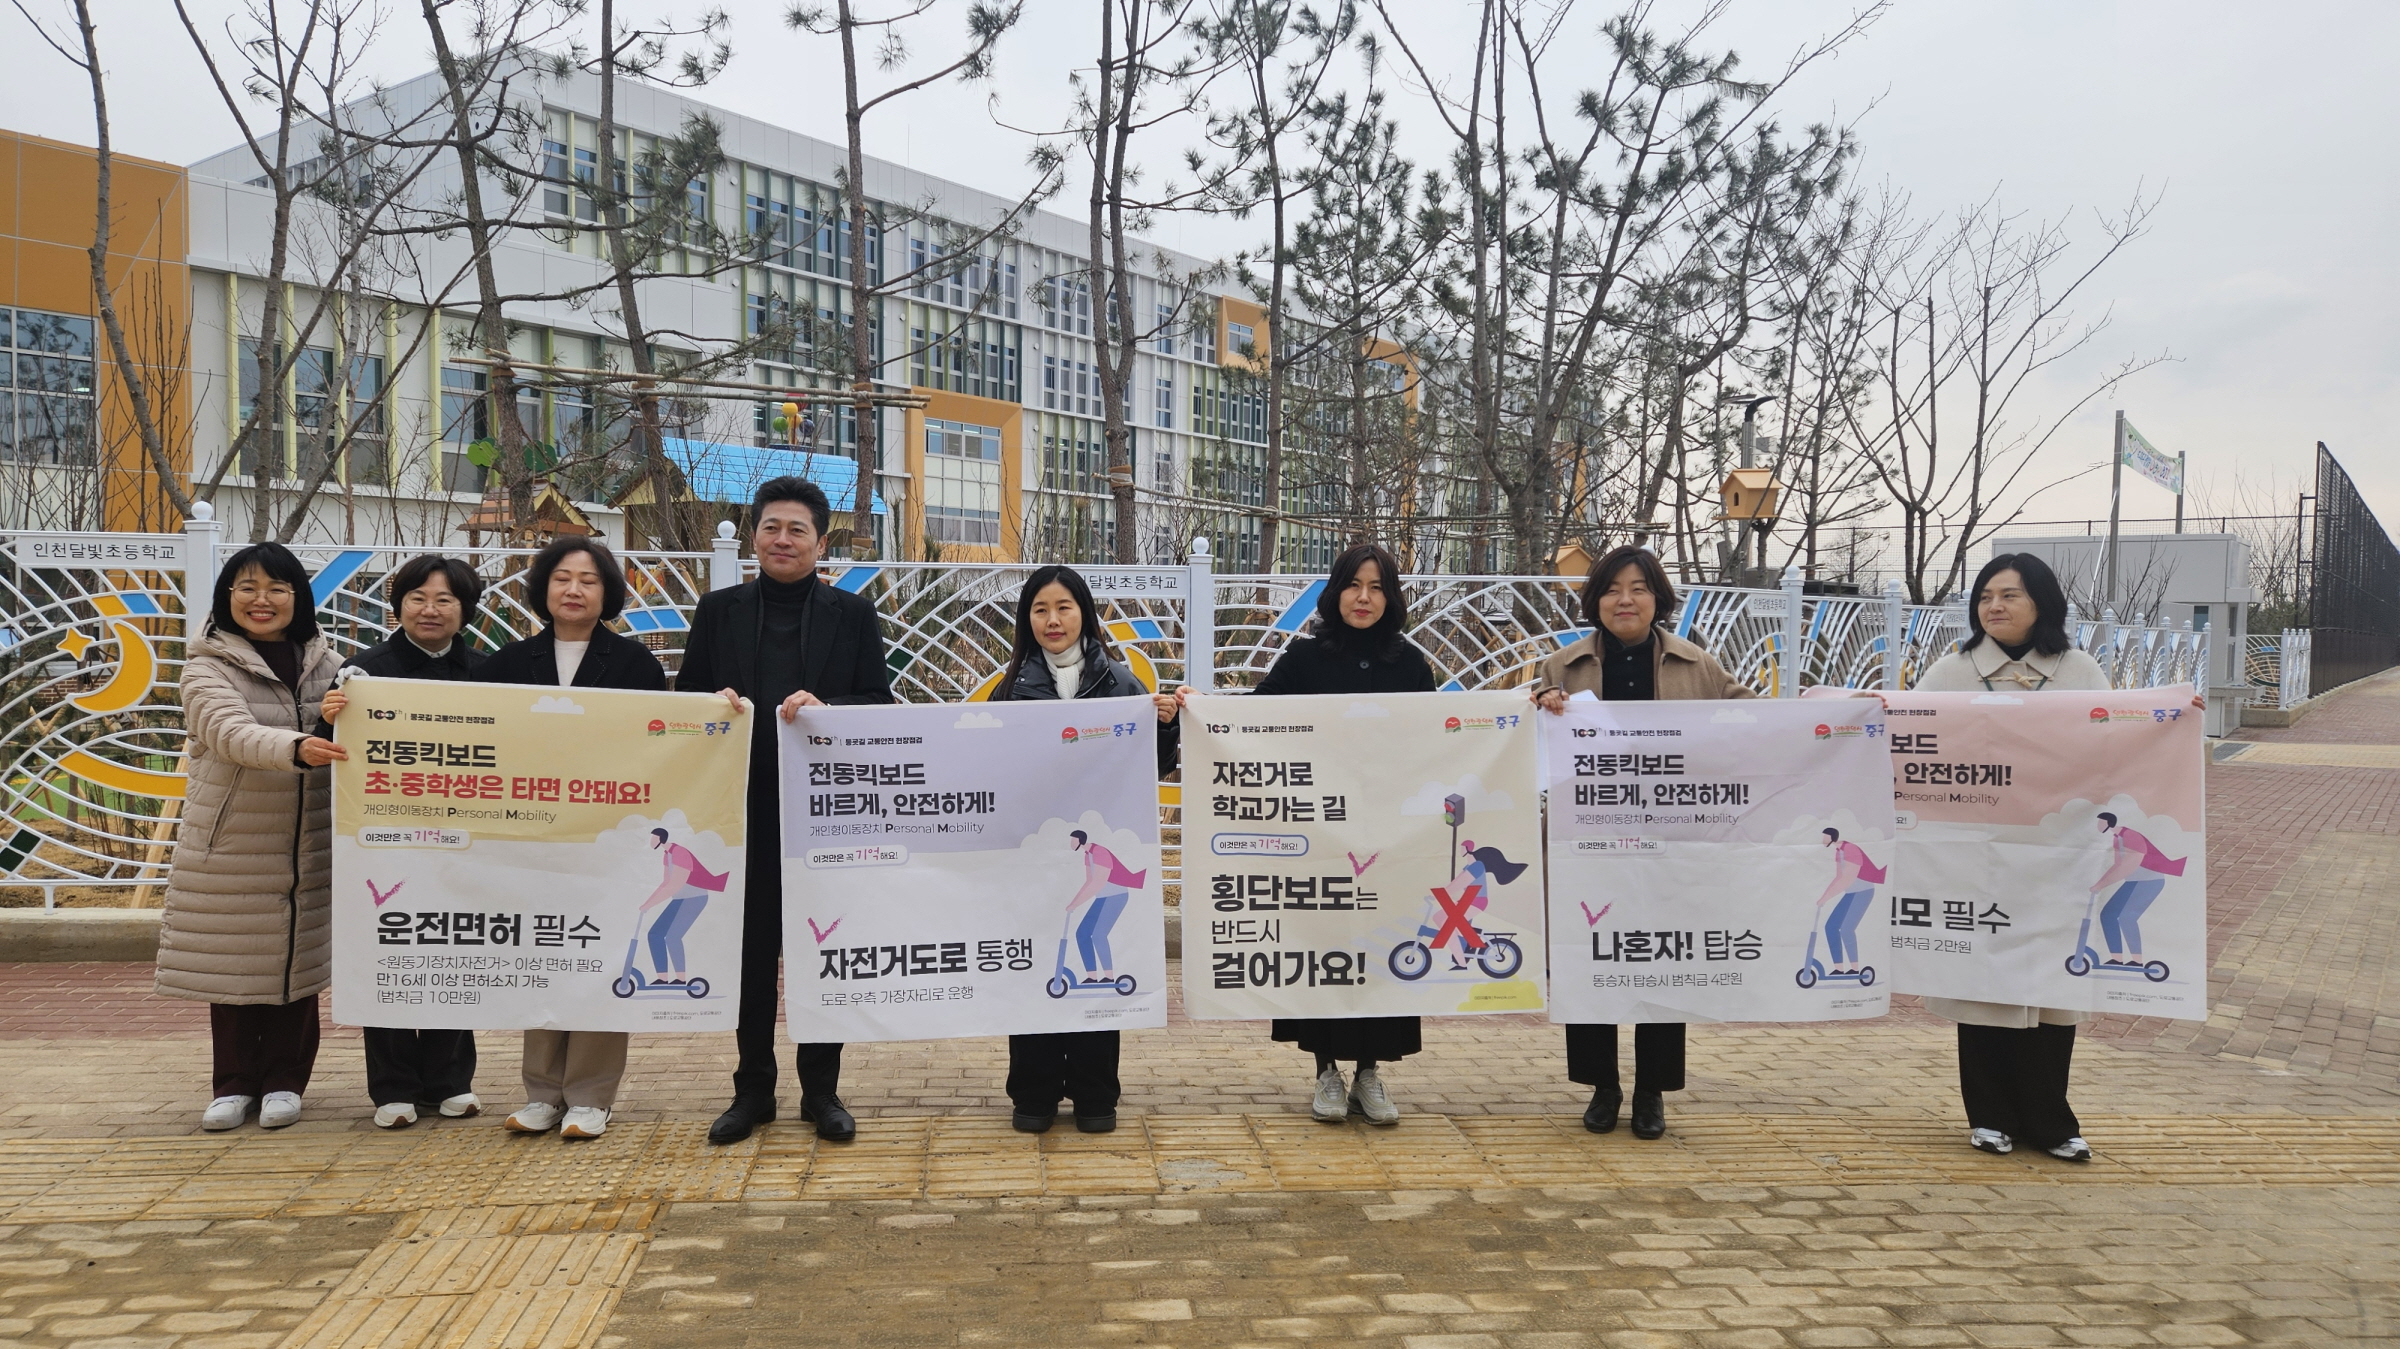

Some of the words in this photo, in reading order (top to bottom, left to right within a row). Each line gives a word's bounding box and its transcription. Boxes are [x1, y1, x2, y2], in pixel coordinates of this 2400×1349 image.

[34, 543, 175, 560] 인천달빛초등학교
[1083, 575, 1178, 590] 달빛초등학교
[1496, 716, 1519, 729] 중구
[2153, 709, 2181, 722] 중구
[705, 722, 730, 735] 중구
[1114, 723, 1136, 737] 중구
[1865, 724, 1884, 737] 중구
[1891, 734, 1938, 754] 보드
[366, 740, 496, 767] 전동킥보드
[1574, 754, 1684, 776] 전동킥보드
[809, 763, 925, 786] 전동킥보드
[1213, 762, 1313, 787] 자전거로
[1904, 763, 2011, 786] 안전하게!
[365, 771, 503, 799] 초·중학생은
[512, 777, 560, 802] 타면
[568, 780, 650, 804] 안돼요!
[1576, 784, 1647, 809] 바르게,
[1654, 784, 1748, 805] 안전하게!
[810, 794, 887, 818] 바르게,
[894, 792, 995, 815] 안전하게!
[1895, 792, 1945, 801] Personal
[1950, 794, 1999, 806] Mobility
[364, 805, 443, 817] 개인형이동장치
[448, 808, 503, 818] Personal
[506, 807, 557, 823] Mobility
[1213, 795, 1314, 822] 학교가는
[1323, 796, 1346, 821] 길
[1576, 814, 1642, 824] 개인형이동장치
[1645, 814, 1692, 824] Personal
[1695, 814, 1739, 826] Mobility
[366, 832, 400, 841] 이것만은
[810, 824, 882, 836] 개인형이동장치
[886, 824, 934, 833] Personal
[938, 823, 984, 833] Mobility
[1219, 840, 1248, 849] 이것만은
[1578, 842, 1607, 850] 이것만은
[814, 854, 844, 863] 이것만은
[1212, 874, 1378, 912] 횡단보도는
[1943, 901, 2010, 934] 필수
[378, 912, 521, 946] 운전면허
[534, 915, 600, 948] 필수
[1212, 919, 1279, 944] 반드시
[1593, 930, 1693, 962] 나혼자!
[1705, 930, 1762, 960] 탑승
[1891, 936, 1929, 950] 범칙금
[1935, 940, 1971, 954] 2만원
[378, 956, 510, 970] <원동기장치자전거>
[515, 958, 543, 970] 이상
[547, 958, 572, 971] 면허
[577, 959, 602, 972] 필요
[820, 943, 967, 980] 자전거도로
[977, 939, 1032, 972] 통행
[1213, 951, 1365, 989] 걸어가요!
[377, 973, 426, 986] 만16세
[432, 974, 459, 986] 이상
[463, 974, 517, 987] 면허소지
[523, 975, 549, 988] 가능
[1593, 975, 1630, 987] 동승자
[1634, 975, 1668, 987] 탑승시
[1673, 974, 1707, 986] 범칙금
[1711, 973, 1742, 985] 4만원
[378, 990, 423, 1004] (범칙금
[430, 991, 480, 1004] 10만원)
[822, 994, 847, 1006] 도로
[851, 992, 876, 1005] 우측
[881, 988, 943, 1003] 가장자리로
[949, 986, 973, 999] 운행
